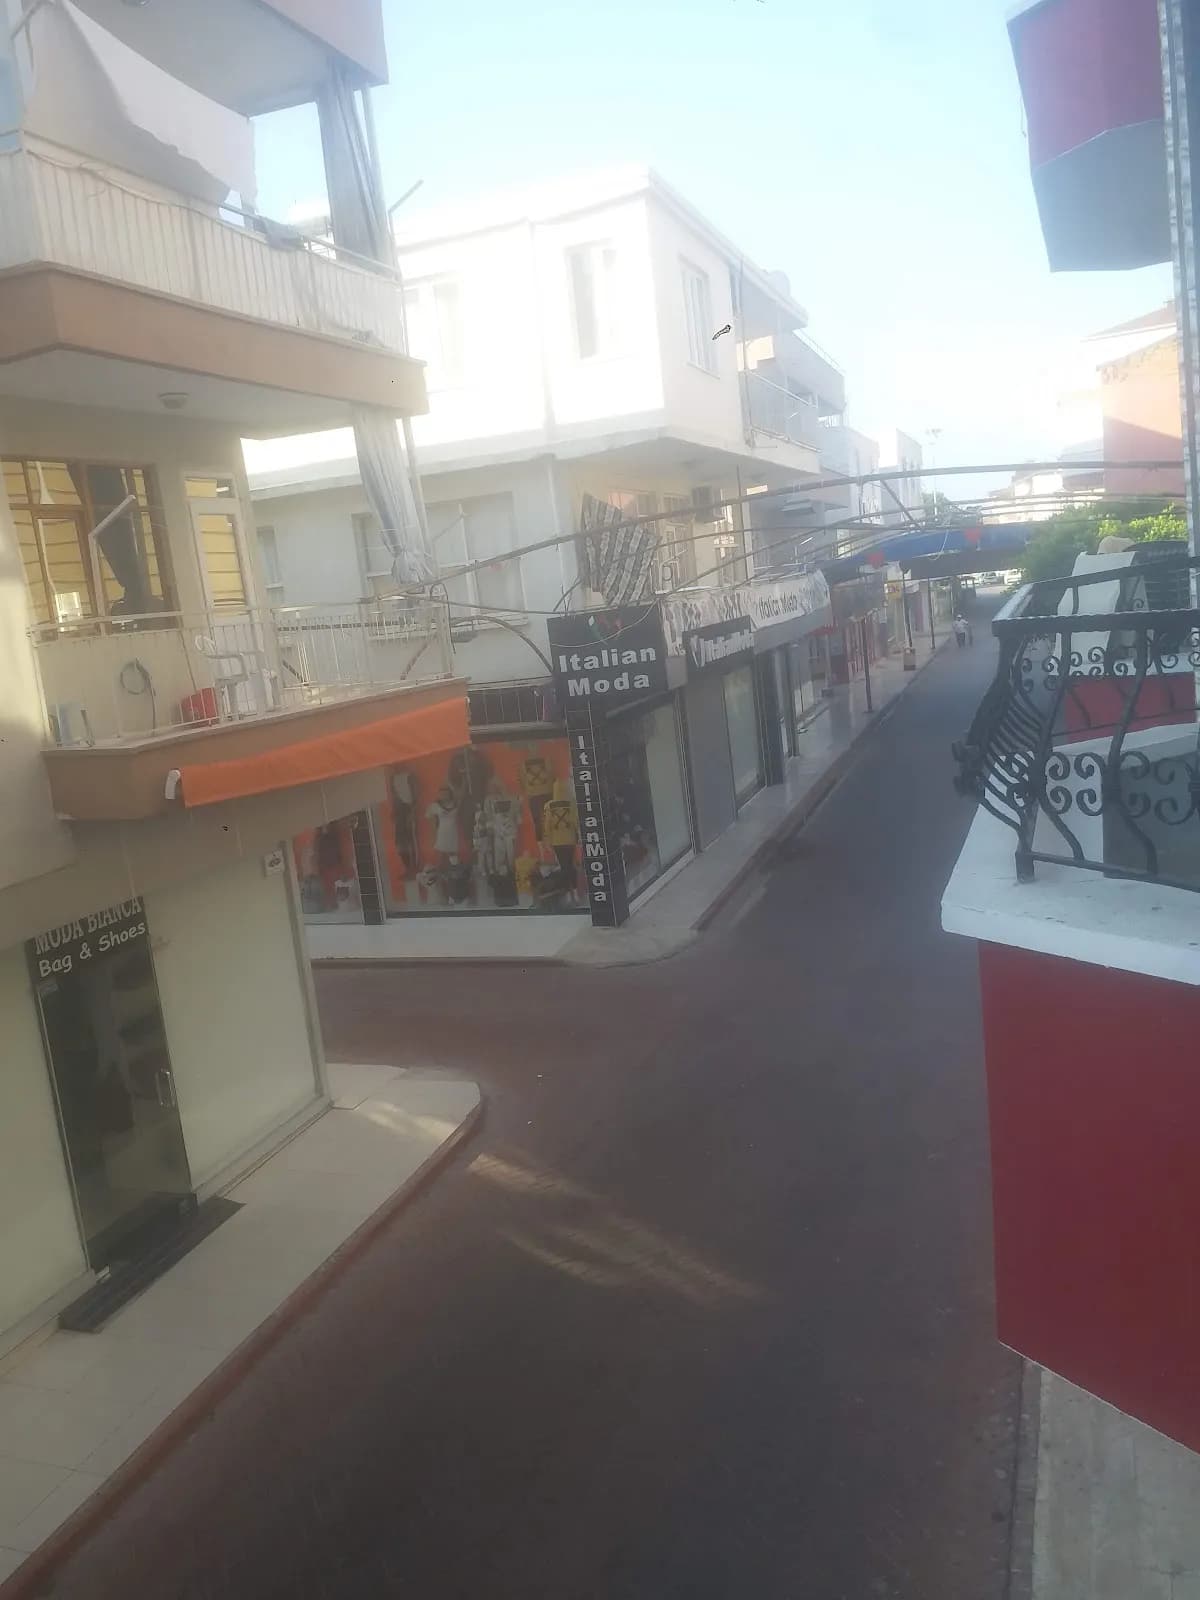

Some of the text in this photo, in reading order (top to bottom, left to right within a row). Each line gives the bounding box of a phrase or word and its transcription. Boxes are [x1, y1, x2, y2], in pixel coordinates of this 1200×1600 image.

[558, 647, 657, 673] Italian
[567, 672, 650, 697] Moda
[34, 897, 142, 955] MODA BIANCA
[39, 922, 146, 978] Bag & Shoes
